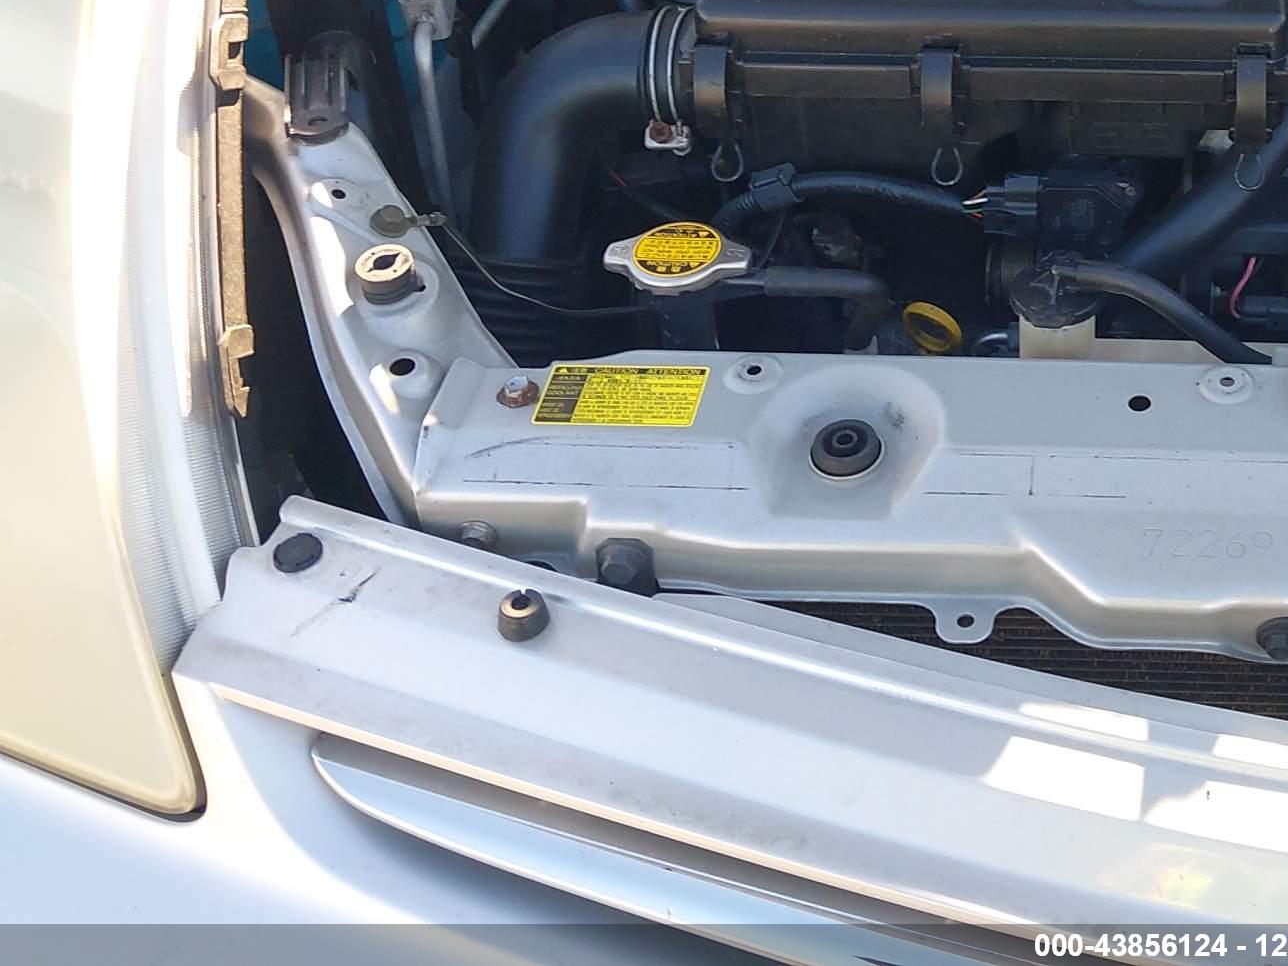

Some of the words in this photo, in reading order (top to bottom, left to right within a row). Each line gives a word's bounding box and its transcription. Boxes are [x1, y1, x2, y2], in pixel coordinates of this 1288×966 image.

[594, 367, 639, 375] CAUTION
[646, 368, 702, 376] ATTENTION
[1143, 528, 1273, 558] 72269
